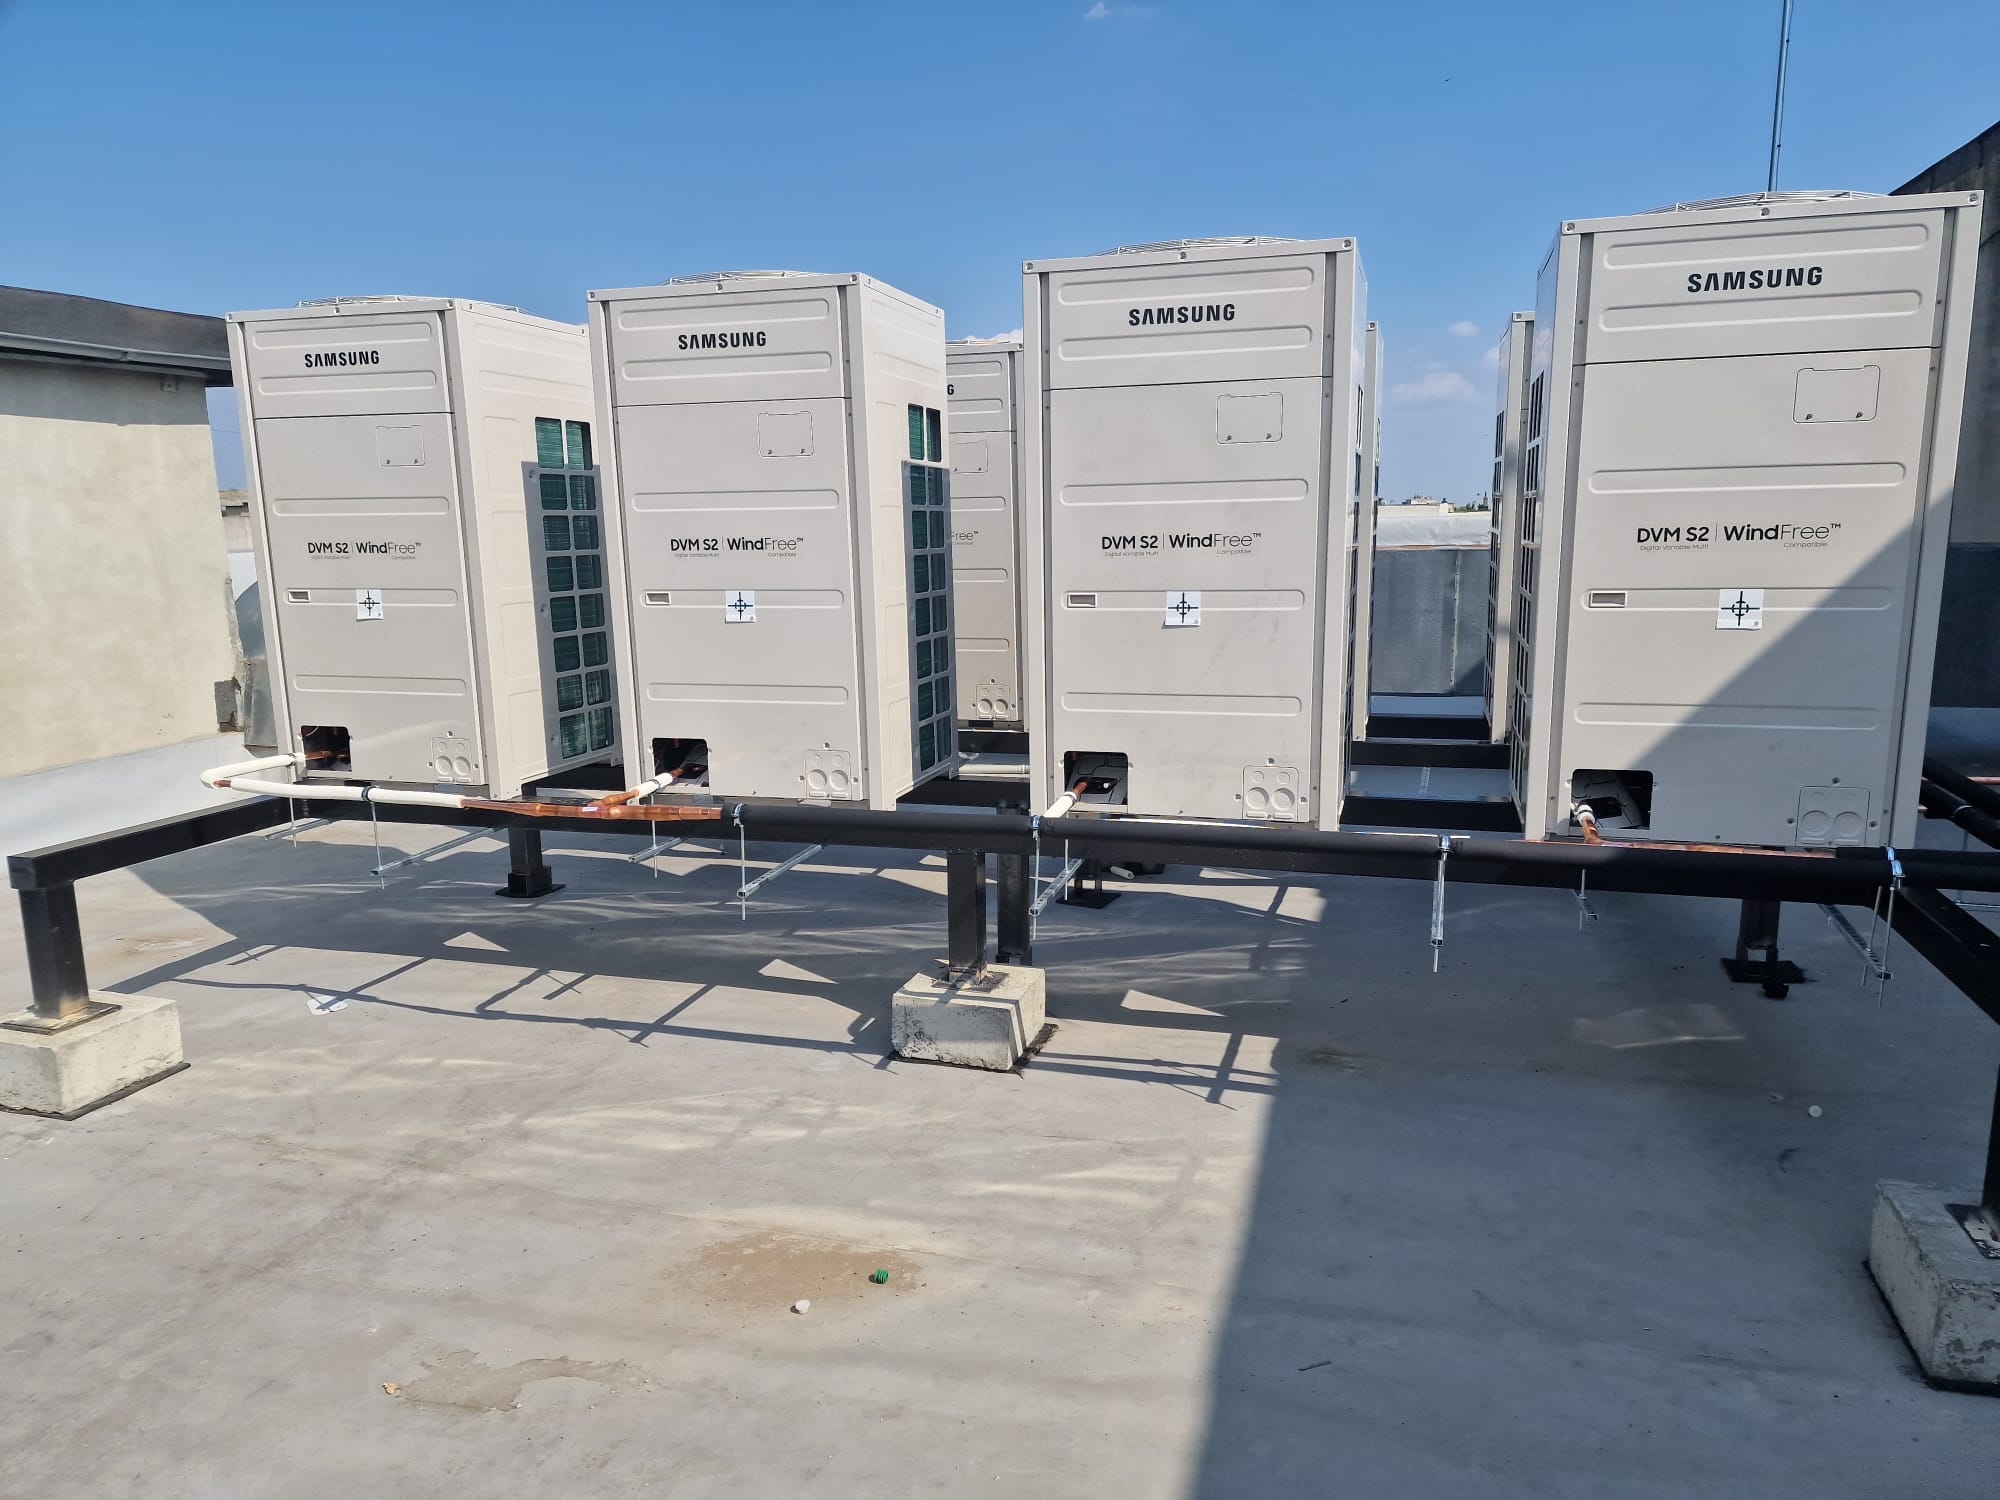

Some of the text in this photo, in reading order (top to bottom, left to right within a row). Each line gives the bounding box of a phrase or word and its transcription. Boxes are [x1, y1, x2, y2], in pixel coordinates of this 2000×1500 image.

[1687, 266, 1823, 293] SAMSUNG
[1128, 303, 1236, 326] SAMSUNG
[678, 331, 767, 350] SAMSUNG
[304, 350, 380, 368] SAMSUNG
[1101, 535, 1136, 550] DVM
[1140, 534, 1159, 549] S2
[1637, 526, 1681, 543] DVM
[1685, 526, 1710, 542] S2
[307, 542, 333, 554] DVM
[335, 542, 349, 554] S2
[670, 538, 700, 551] DVM
[703, 538, 719, 551] S2
